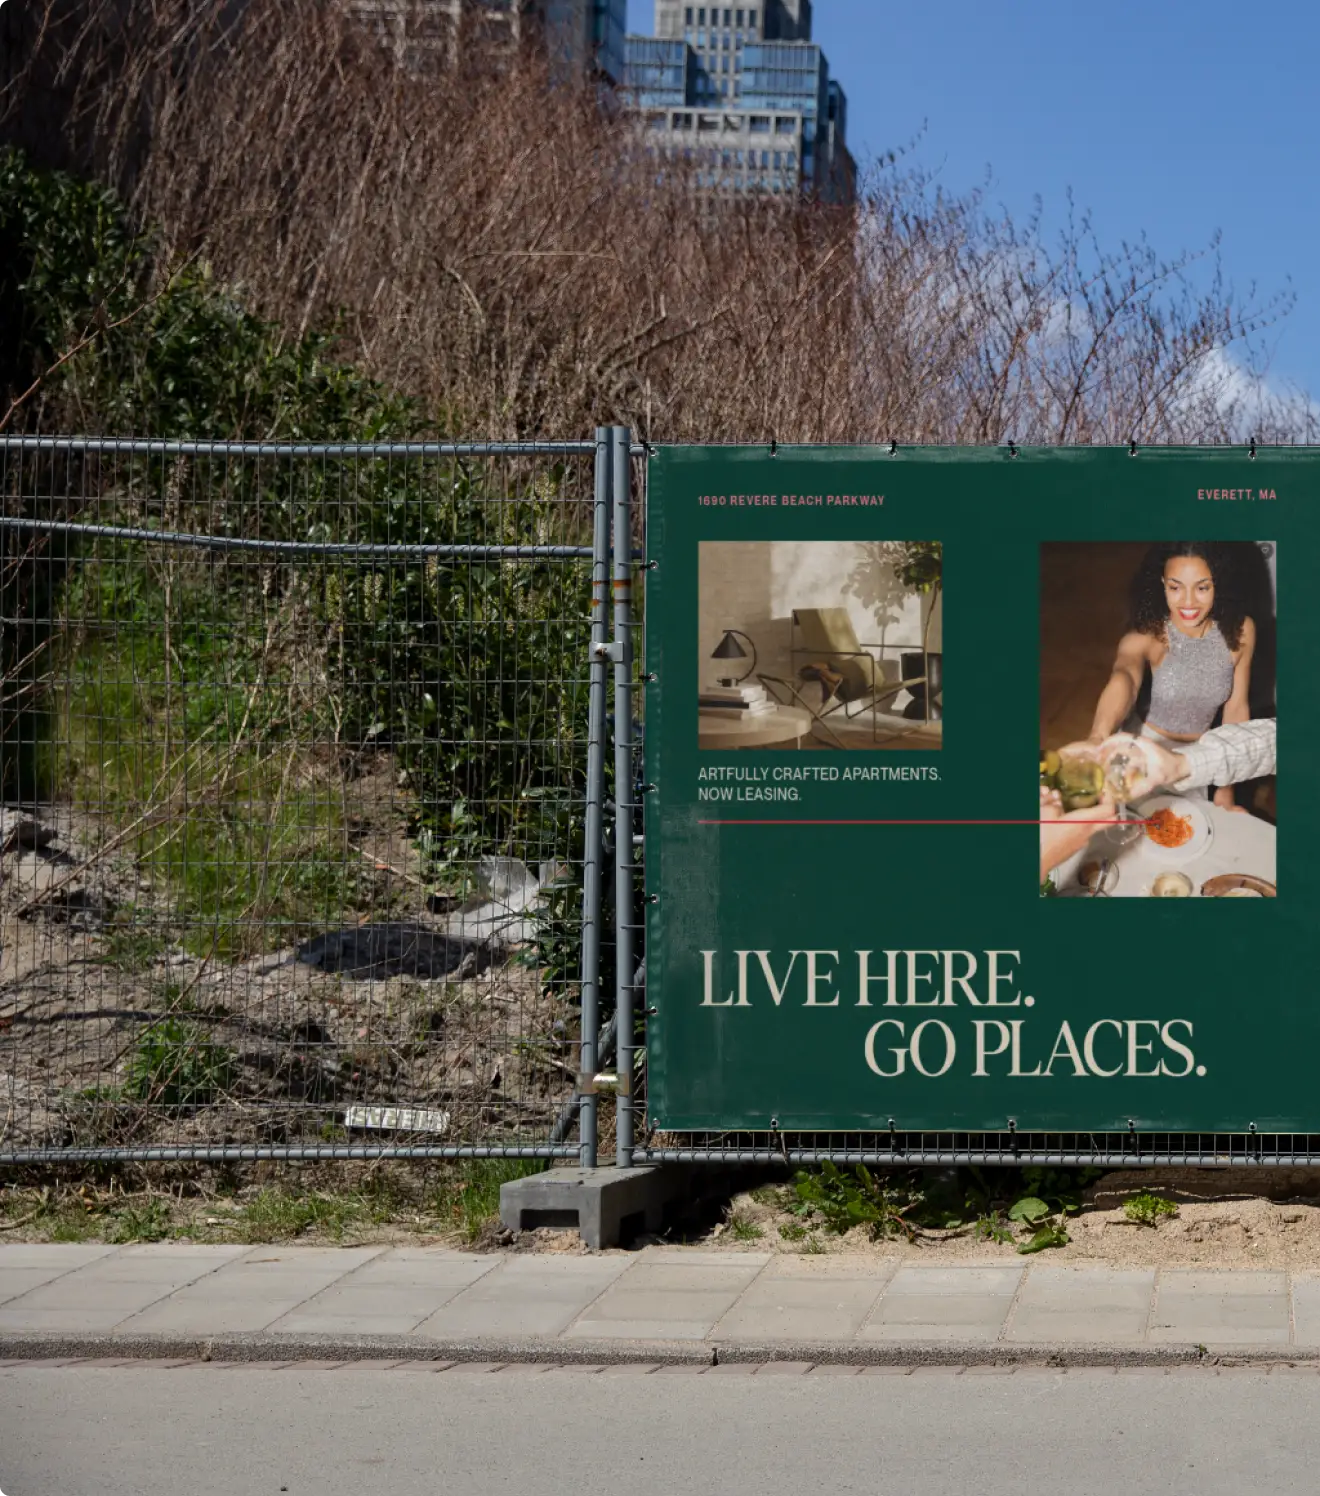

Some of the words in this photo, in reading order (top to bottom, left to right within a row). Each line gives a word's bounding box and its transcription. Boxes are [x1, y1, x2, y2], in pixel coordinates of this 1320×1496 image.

[698, 495, 727, 506] 1690
[730, 495, 778, 506] REVERE
[782, 495, 823, 506] BEACH
[826, 495, 885, 506] PARKWAY
[1197, 488, 1255, 501] EVERETT,
[1259, 488, 1277, 500] MA
[698, 767, 769, 781] ARTFULLY
[772, 767, 839, 781] CRAFTED
[842, 767, 942, 781] APARTMENTS.
[698, 787, 734, 801] NOW
[736, 787, 802, 801] LEASING.
[699, 949, 840, 1007] LIVE
[855, 949, 1036, 1008] HERE.
[864, 1019, 957, 1077] GO
[971, 1019, 1208, 1077] PLACES.
